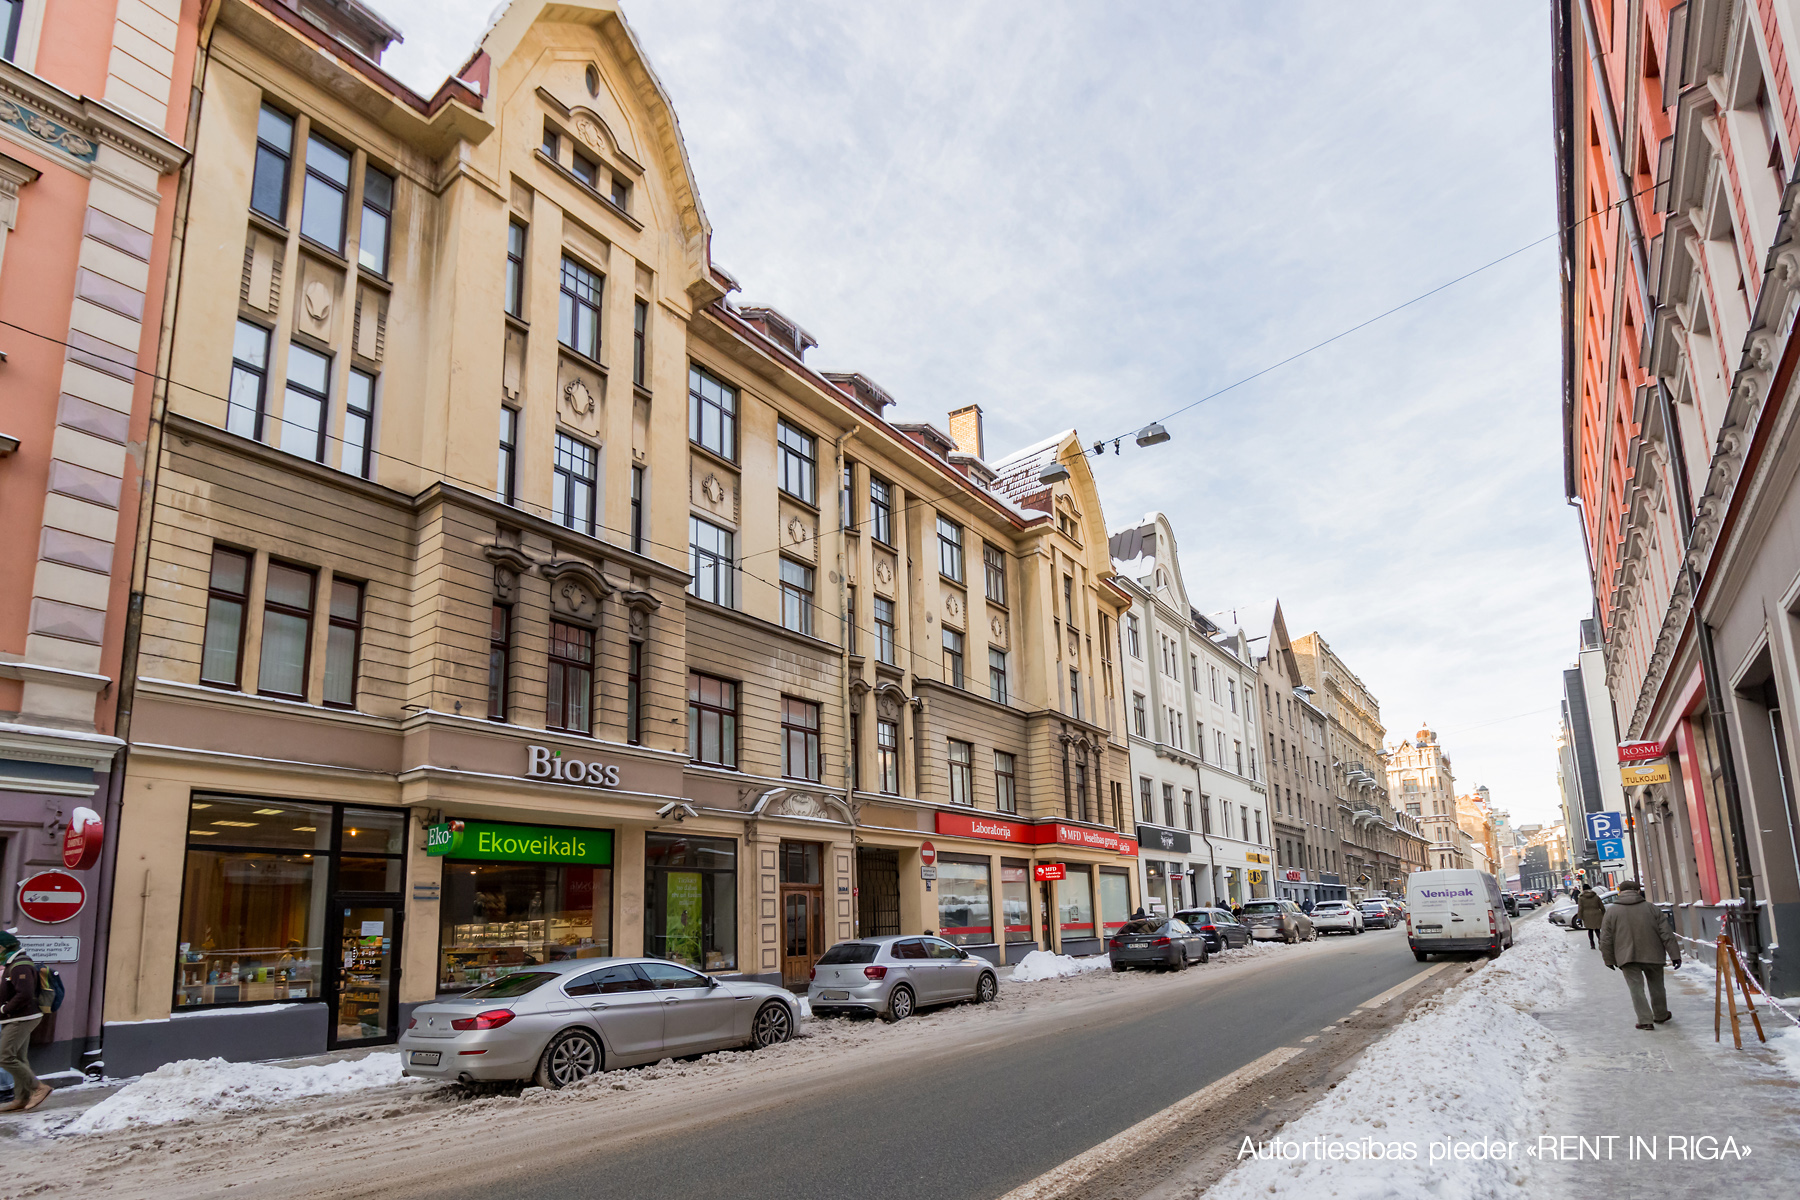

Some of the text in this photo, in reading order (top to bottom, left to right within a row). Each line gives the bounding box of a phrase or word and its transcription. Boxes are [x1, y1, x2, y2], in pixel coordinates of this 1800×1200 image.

[1622, 745, 1660, 756] ROSME
[525, 745, 620, 787] Bioss
[1625, 774, 1667, 784] TULKOJUMI
[428, 827, 452, 846] Eko-
[971, 821, 1011, 839] Laboratorija
[1593, 819, 1611, 838] P
[478, 832, 586, 857] Ekoveikals
[1067, 829, 1118, 848] MFD Veselības grupa
[1604, 846, 1614, 857] P
[1421, 888, 1474, 898] Venipak
